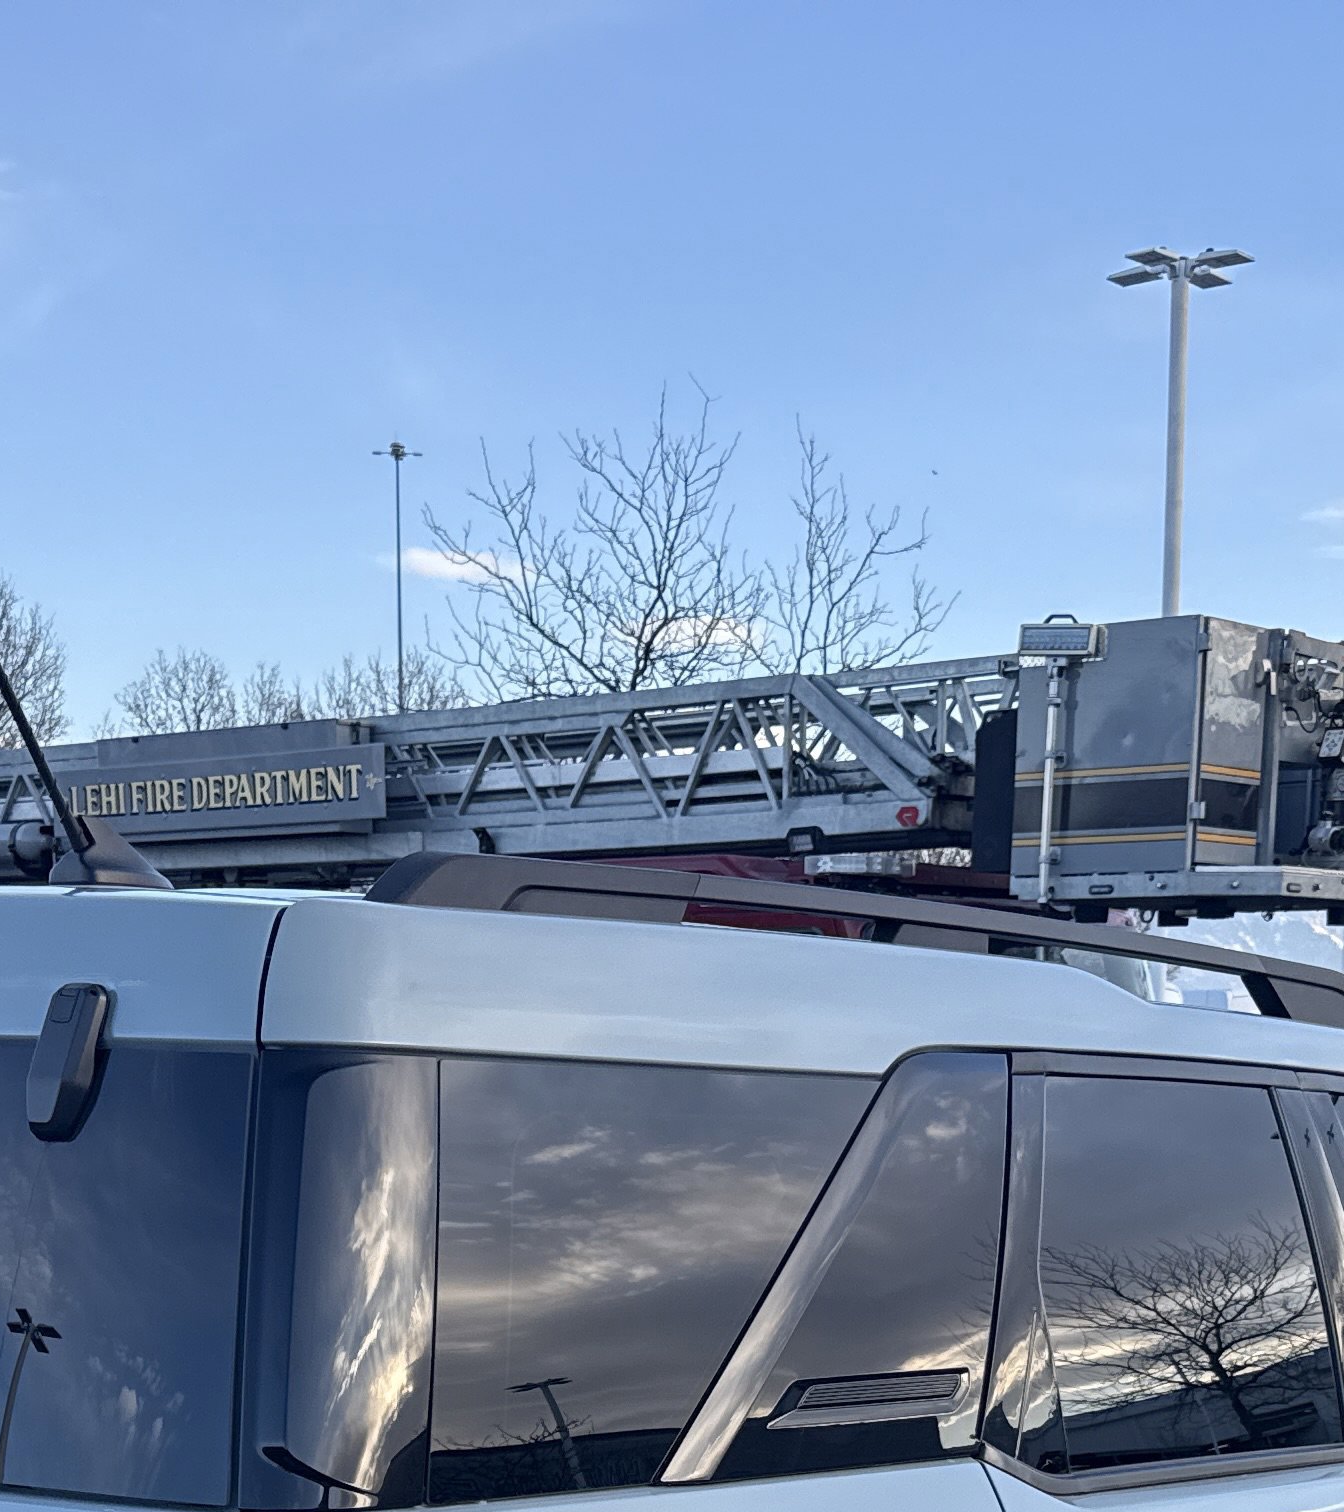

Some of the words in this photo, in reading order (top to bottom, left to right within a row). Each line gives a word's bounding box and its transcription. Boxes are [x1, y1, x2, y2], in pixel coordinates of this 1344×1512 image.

[69, 782, 126, 818] LEHI
[130, 778, 188, 814] FIRE
[191, 763, 363, 811] DEPARTMENT
